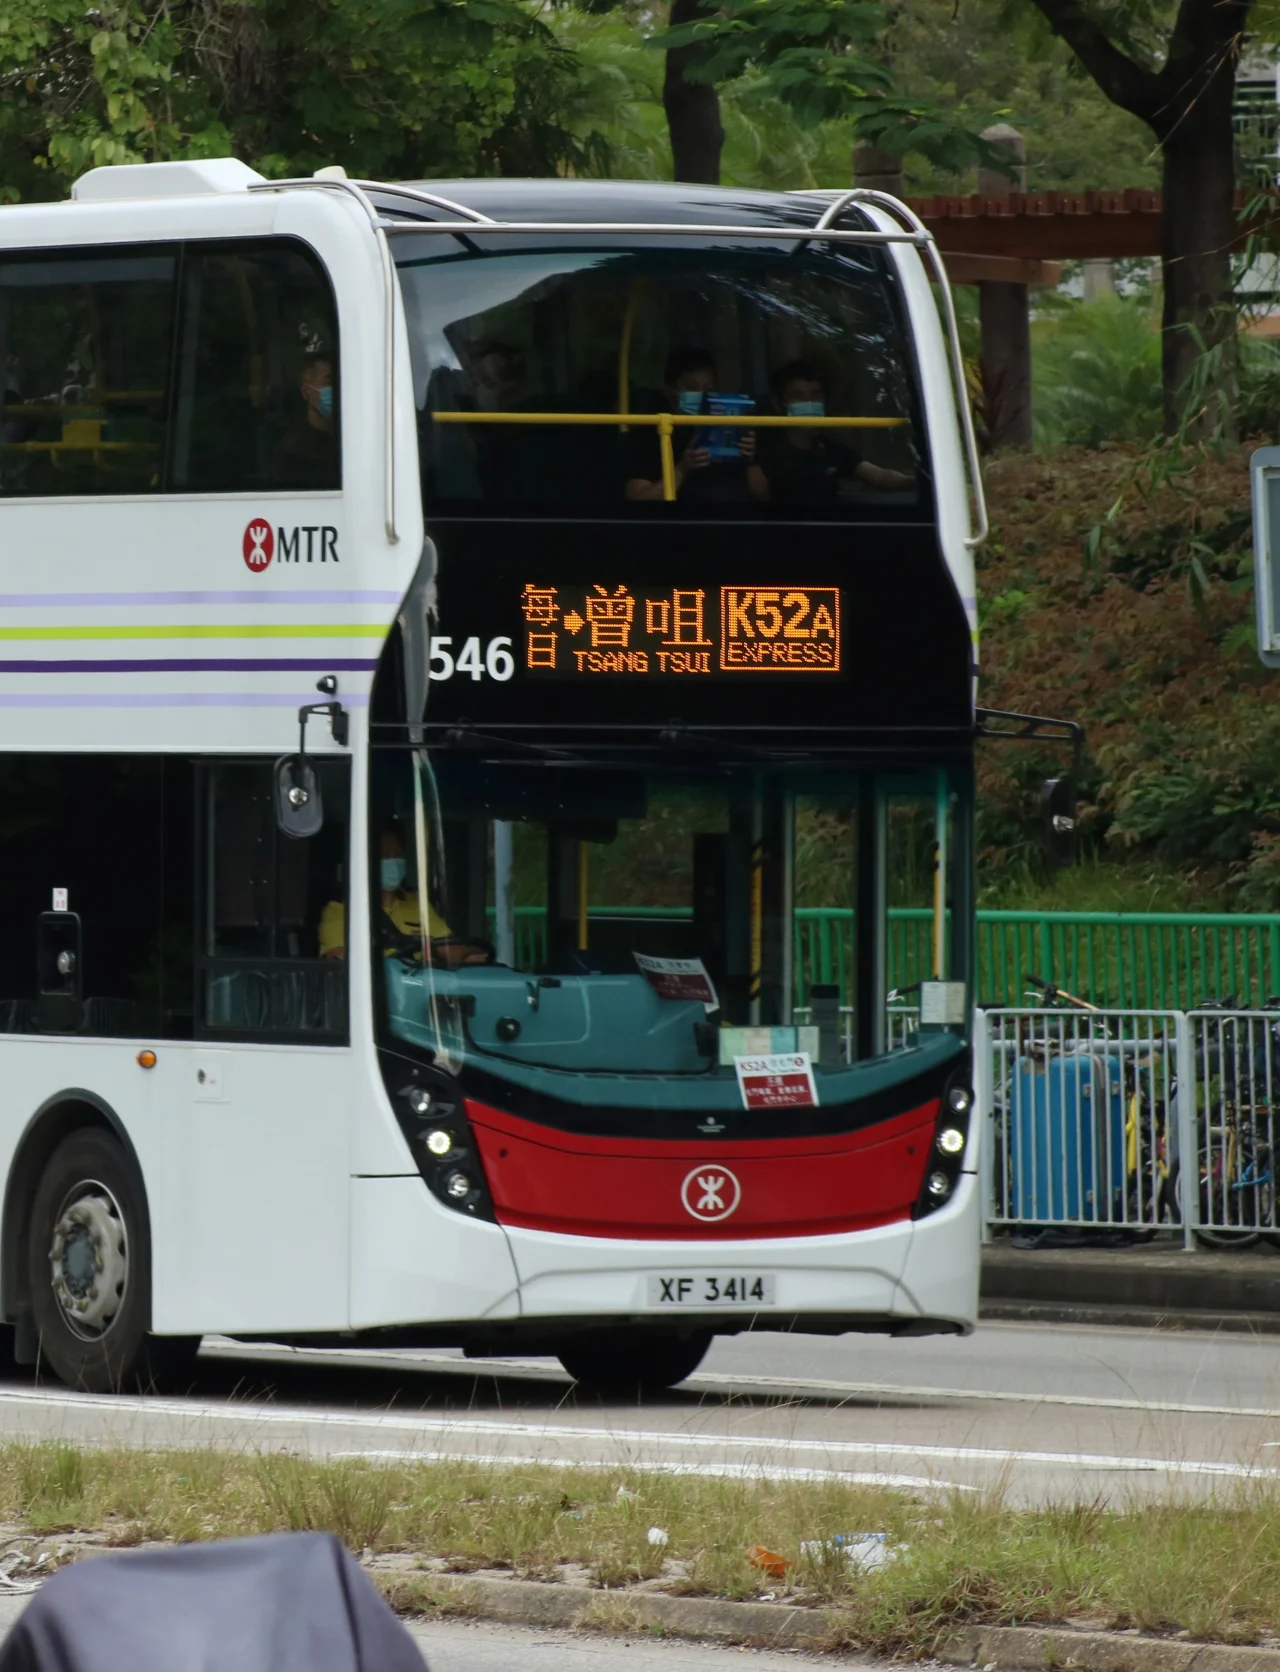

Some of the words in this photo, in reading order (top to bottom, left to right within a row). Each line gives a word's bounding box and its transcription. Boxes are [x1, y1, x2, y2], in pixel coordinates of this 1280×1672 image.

[277, 526, 340, 563] MTR
[586, 585, 713, 647] 曾咀
[727, 592, 835, 638] K52A
[428, 636, 515, 682] 546
[573, 650, 649, 673] TSANG
[655, 650, 711, 673] TSUI
[727, 642, 834, 664] EXPRESS
[659, 1278, 694, 1302] XF
[704, 1277, 765, 1301] 3414
